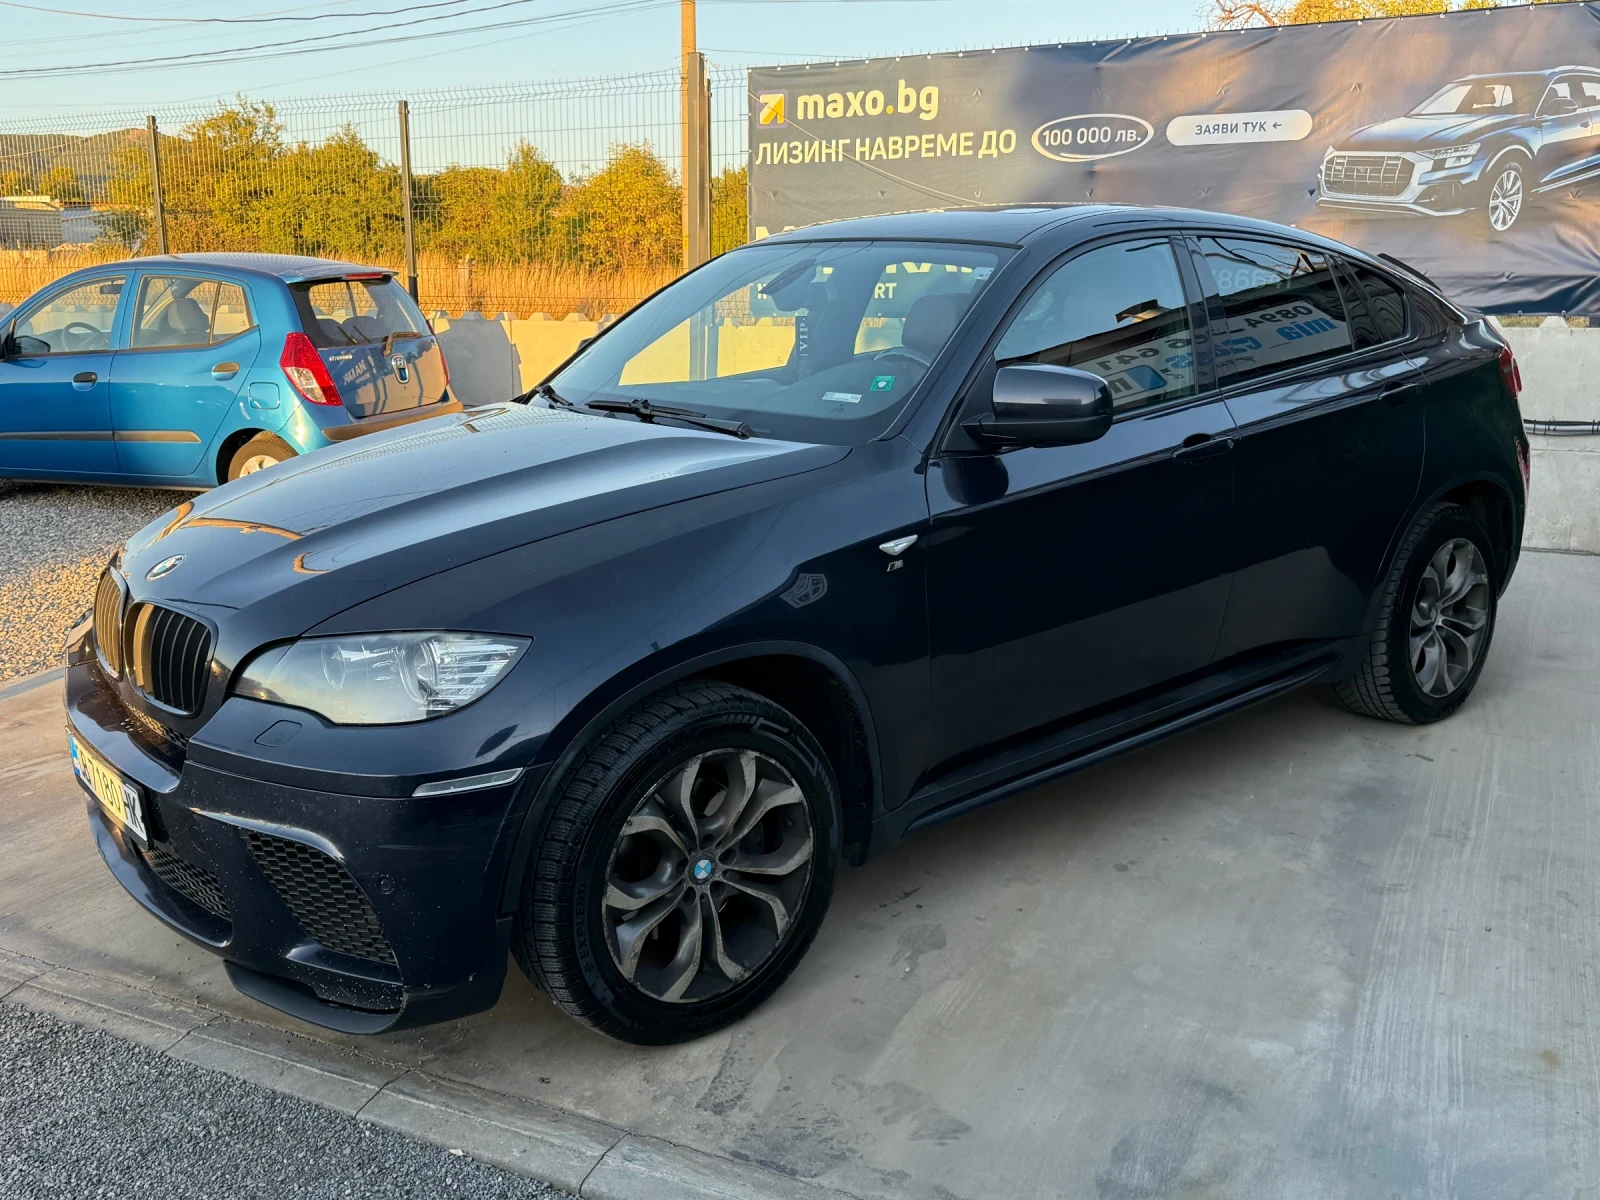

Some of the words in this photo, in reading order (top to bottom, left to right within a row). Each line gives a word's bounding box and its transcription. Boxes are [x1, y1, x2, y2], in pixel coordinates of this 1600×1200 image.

[797, 79, 939, 121] maxo.bg
[1042, 129, 1072, 146] 100
[1076, 126, 1111, 144] 000
[1114, 129, 1141, 142] лв.
[1194, 122, 1239, 136] ЗАЯВИ
[1242, 121, 1267, 133] ТУК
[755, 139, 851, 166] ЛИЗИНГ
[855, 131, 974, 161] НАВРЕМЕ
[977, 129, 1016, 159] ДО
